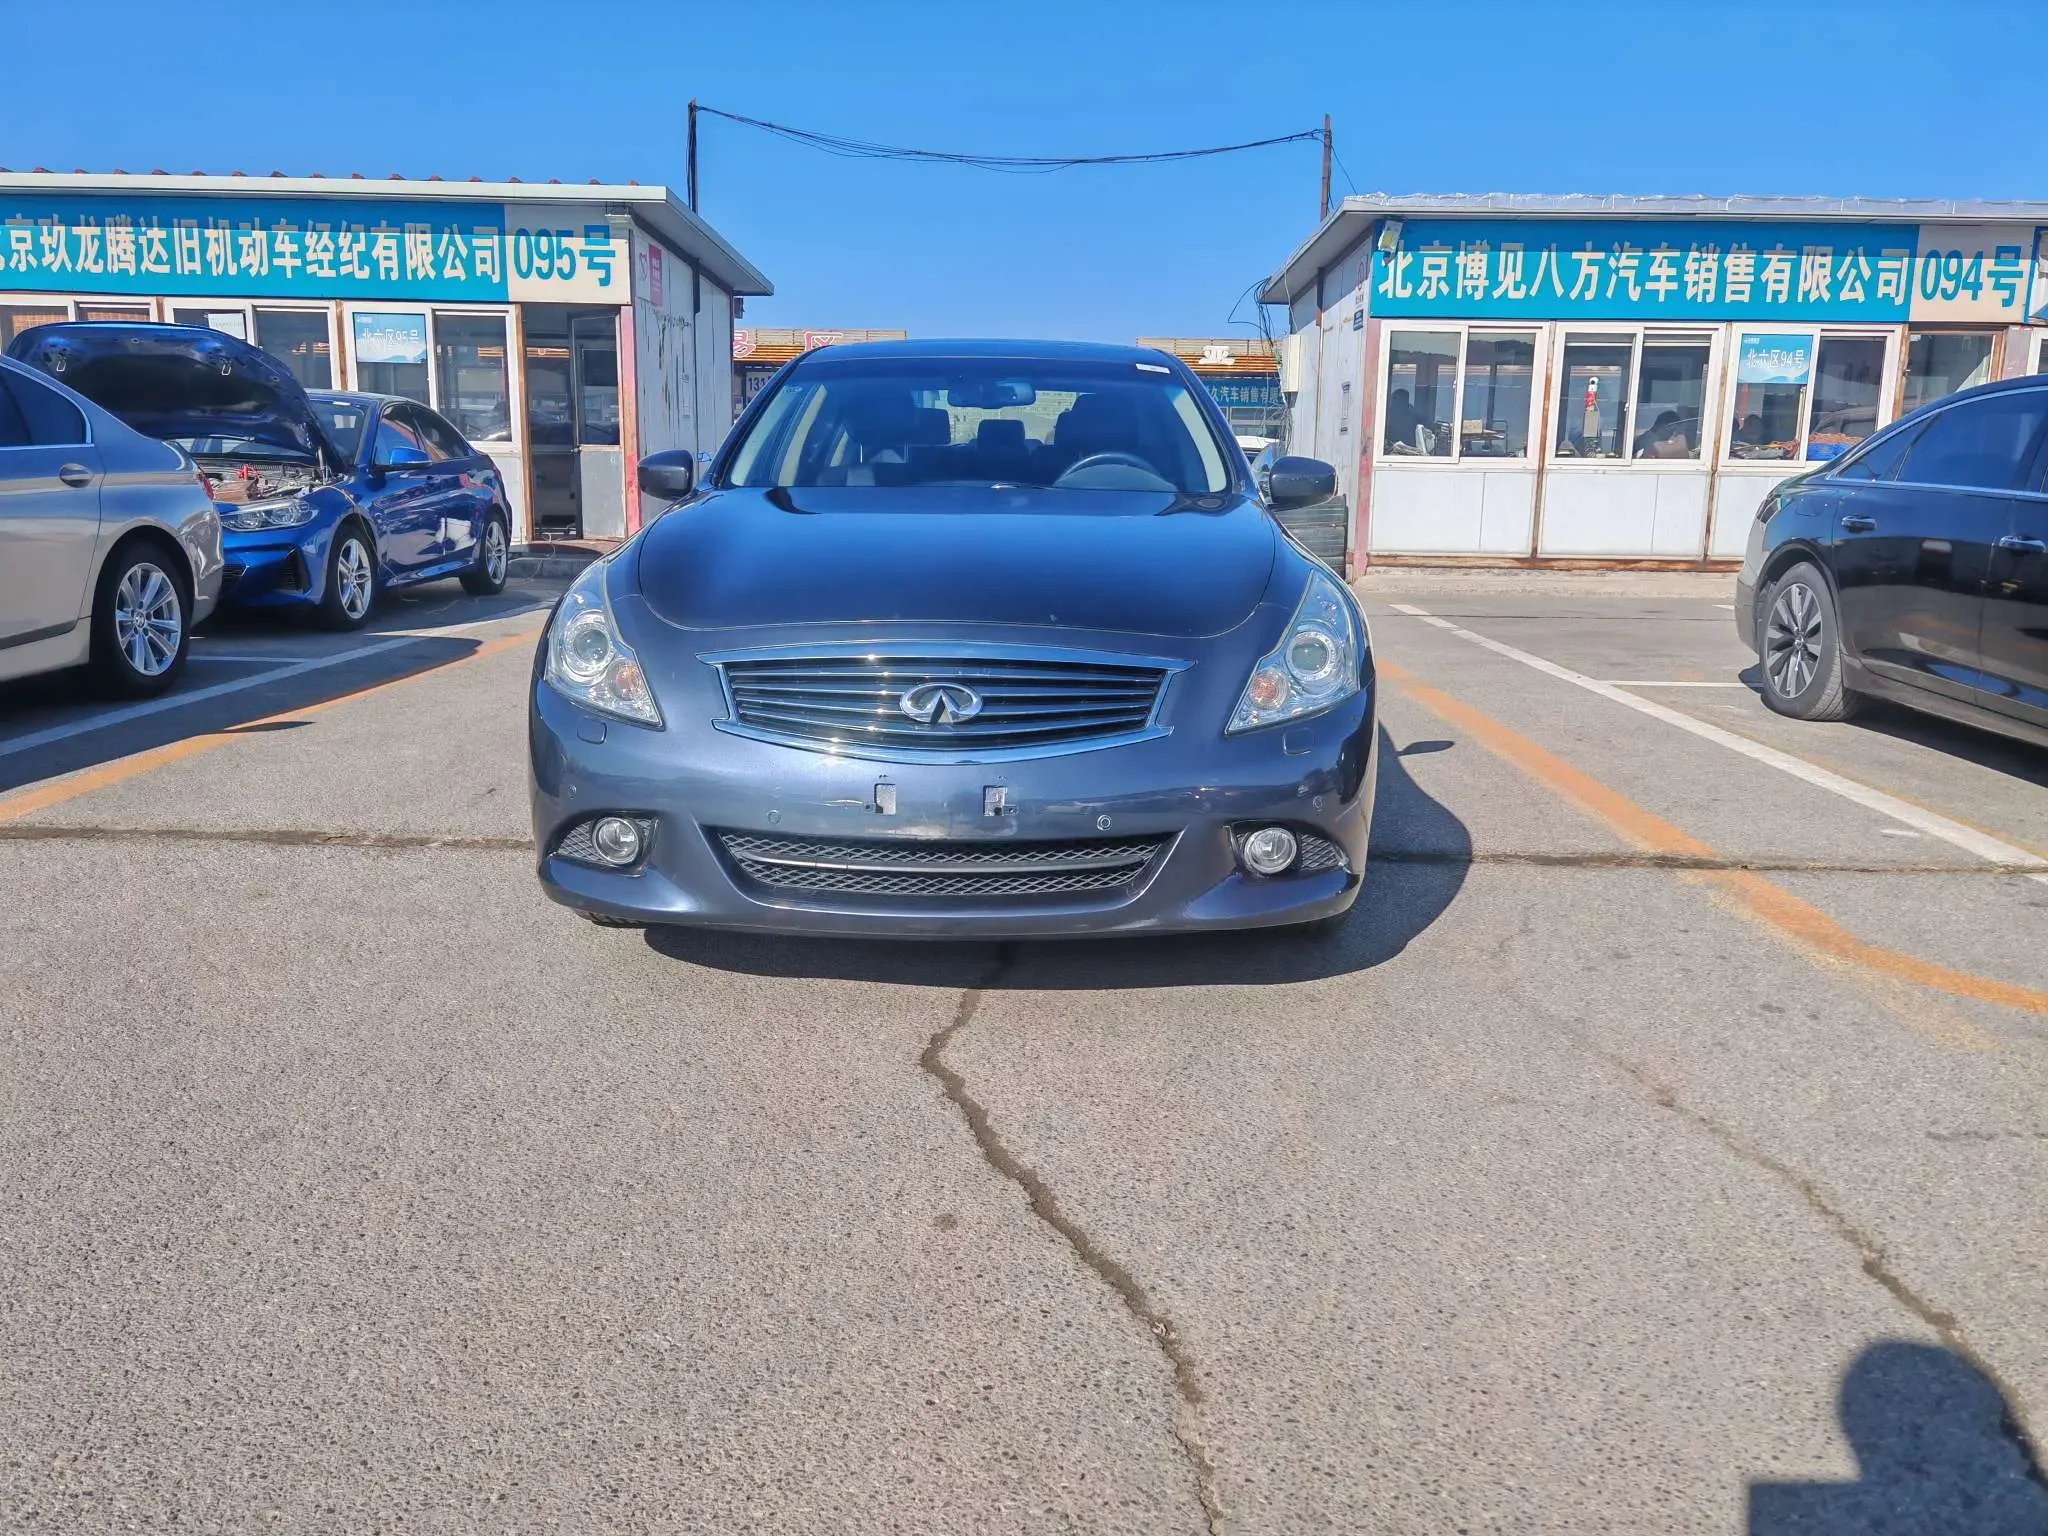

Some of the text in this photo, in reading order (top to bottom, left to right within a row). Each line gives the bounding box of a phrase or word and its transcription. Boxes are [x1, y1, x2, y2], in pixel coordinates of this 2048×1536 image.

[0, 212, 499, 284] 京玖龙腾达旧机动车经纪有限公司
[513, 225, 616, 287] 095号
[1378, 239, 2024, 308] 北京博见八方汽车销售有限公司 094号
